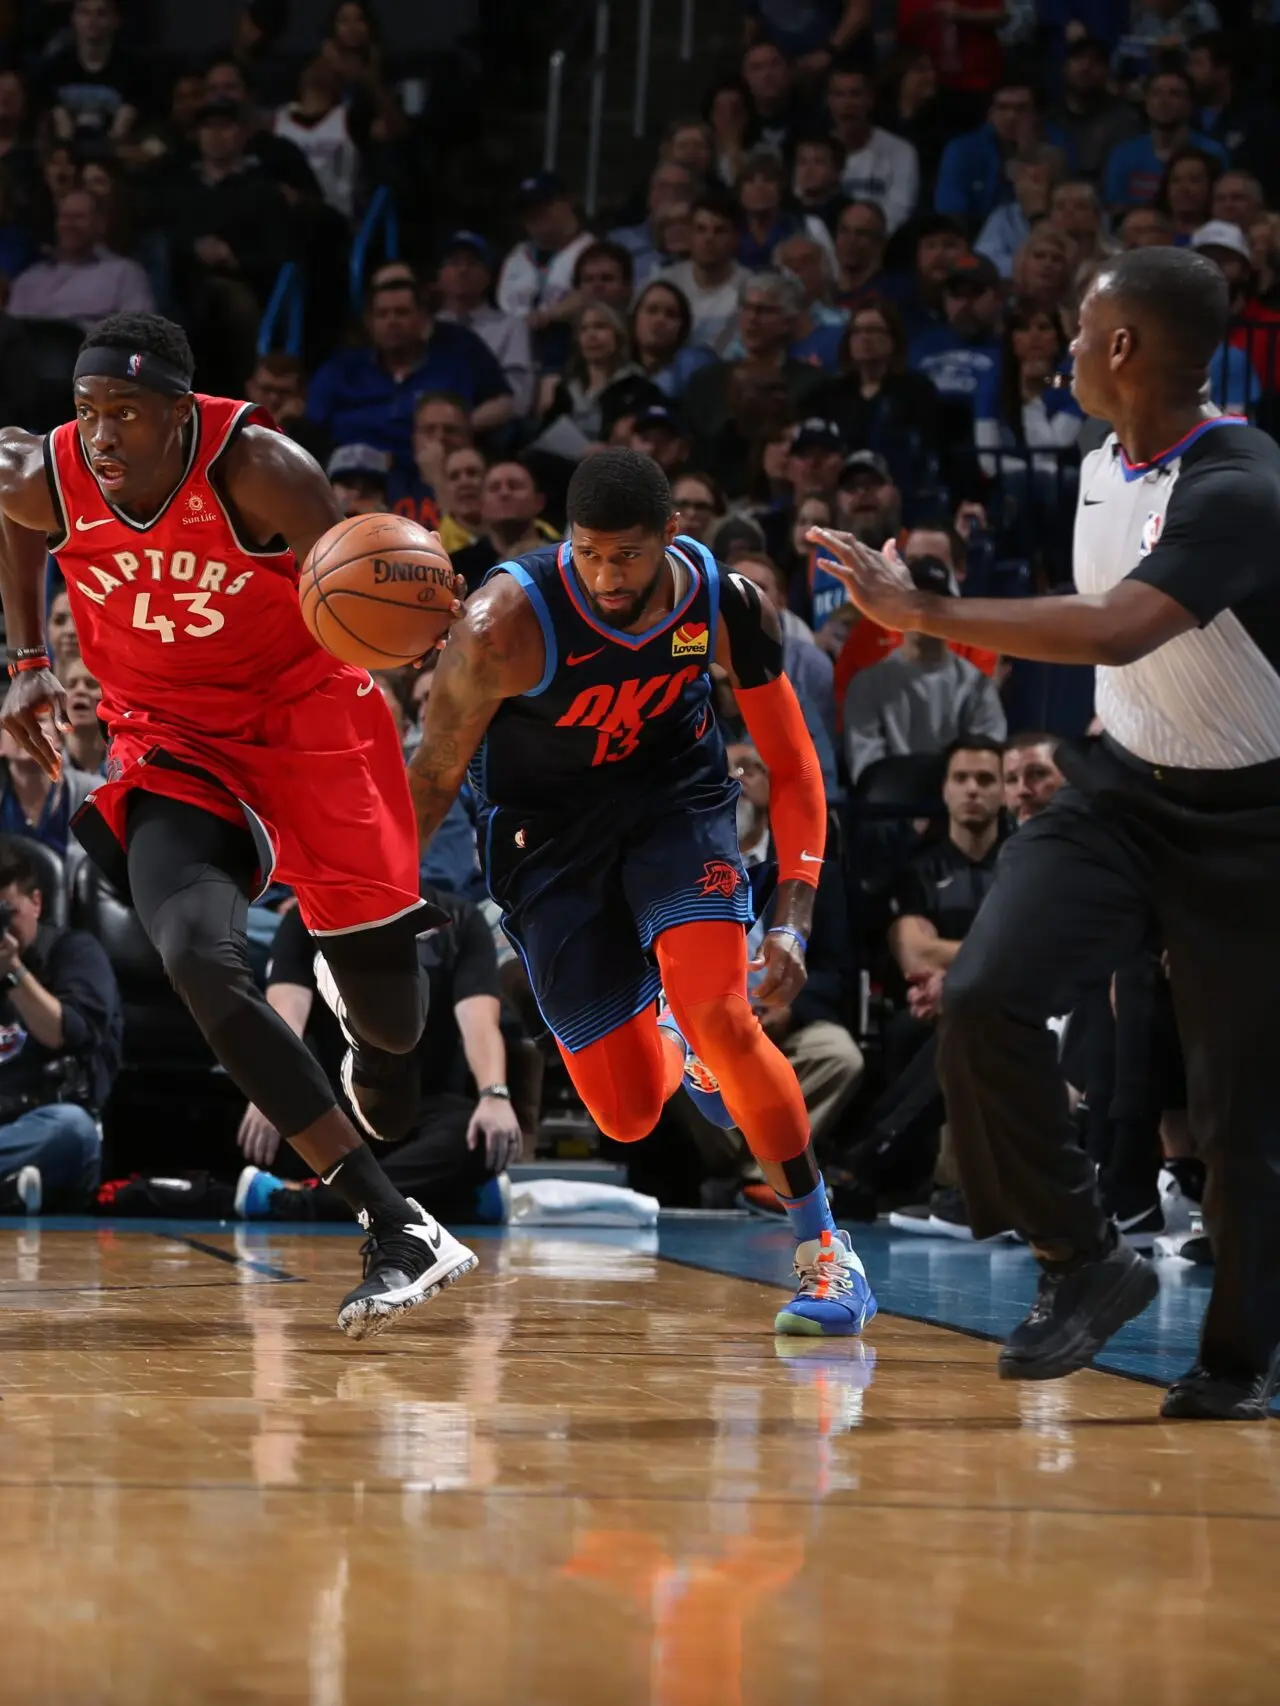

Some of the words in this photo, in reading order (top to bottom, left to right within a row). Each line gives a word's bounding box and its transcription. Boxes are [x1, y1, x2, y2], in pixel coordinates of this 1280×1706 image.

[182, 515, 200, 526] Sun
[201, 512, 217, 522] Life
[76, 549, 255, 606] RAPTORS
[374, 558, 456, 592] PALDING
[132, 591, 225, 643] 43
[591, 720, 644, 768] 13
